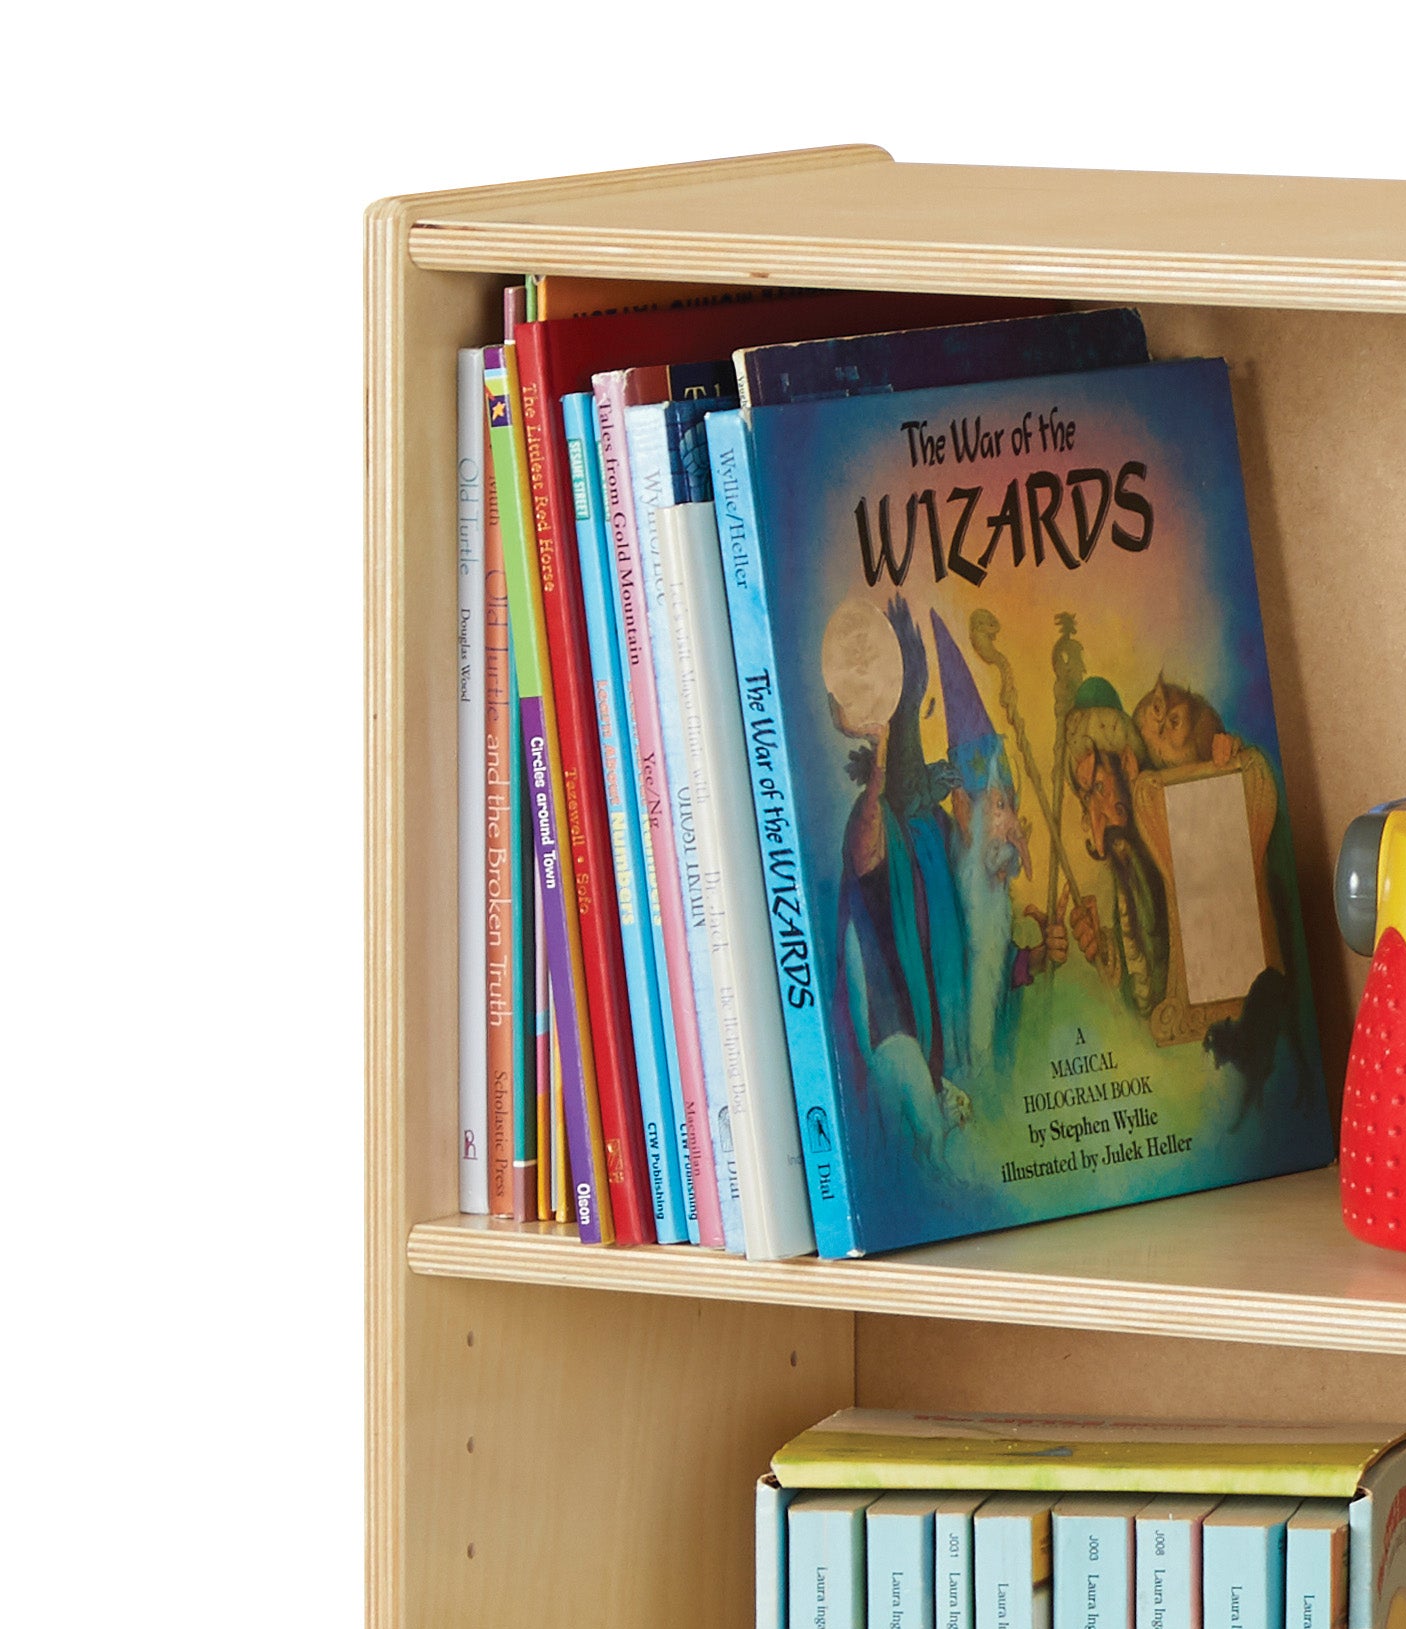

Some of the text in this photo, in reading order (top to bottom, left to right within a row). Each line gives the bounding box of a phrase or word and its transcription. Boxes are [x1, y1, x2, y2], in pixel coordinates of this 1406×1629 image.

[901, 407, 1076, 468] The War of the
[854, 461, 1154, 588] WIZARDS
[618, 564, 642, 668] Mountain
[716, 448, 834, 1200] Wyllie/Heller WIZARDS Dial
[487, 848, 512, 1027] Broken Truth
[1051, 1052, 1118, 1079] MAGICAL
[1024, 1076, 1152, 1114] HOLOGRAM BOOK
[1050, 1107, 1158, 1142] Stephen Wyllie
[1002, 1135, 1193, 1183] illustrated Heller
[576, 1183, 590, 1226] Olson
[816, 1567, 828, 1602] Laura
